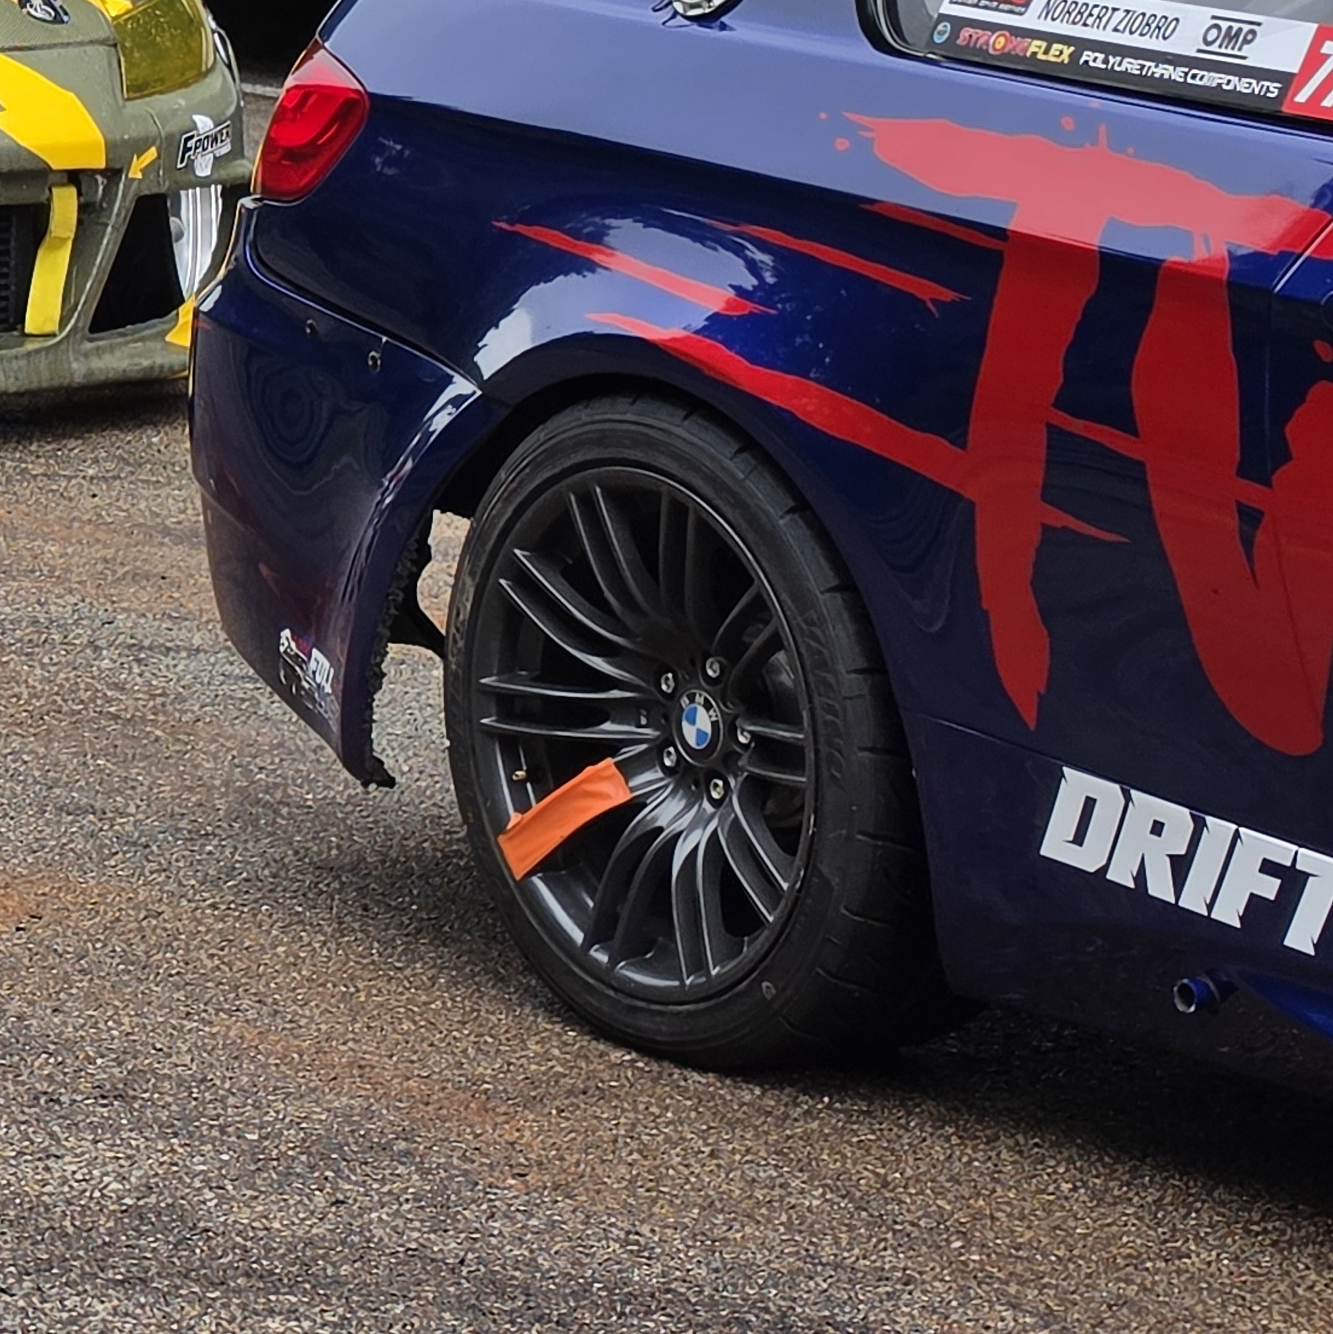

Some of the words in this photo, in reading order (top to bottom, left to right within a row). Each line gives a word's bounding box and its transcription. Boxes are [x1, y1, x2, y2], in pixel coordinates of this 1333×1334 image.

[1115, 8, 1181, 42] ZIOBRO
[1201, 22, 1258, 53] OMP
[1078, 50, 1186, 84] POLYURETHANE
[1186, 70, 1283, 98] COMPONENTS
[1293, 39, 1333, 108] 7
